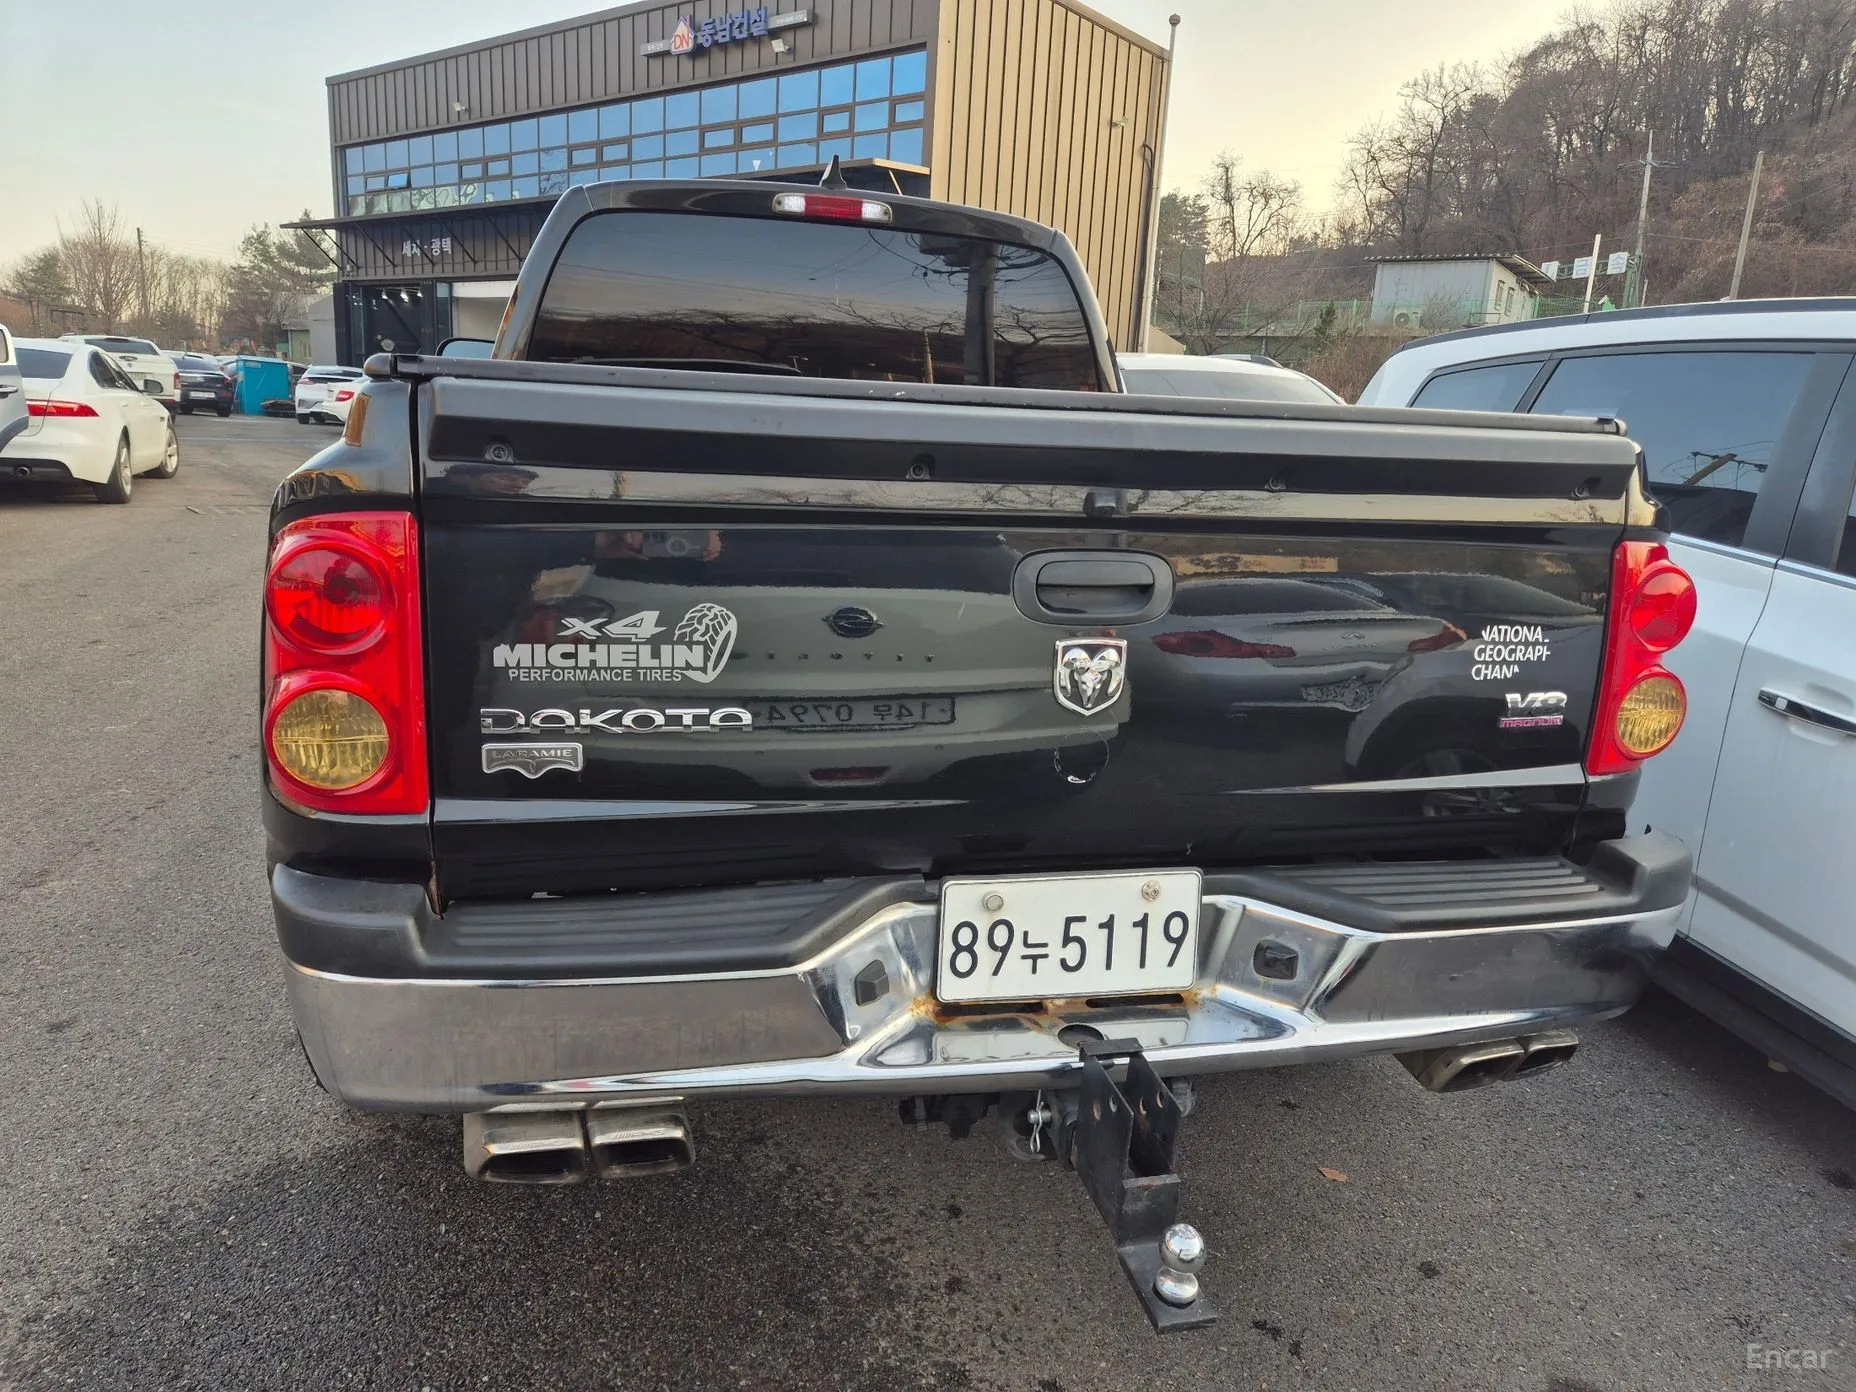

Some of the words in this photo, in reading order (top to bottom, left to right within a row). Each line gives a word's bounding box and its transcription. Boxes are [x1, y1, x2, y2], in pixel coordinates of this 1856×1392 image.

[701, 6, 768, 48] 동남건설
[1481, 625, 1550, 643] NATIONA
[493, 643, 704, 667] MICHELIN
[508, 668, 632, 682] PERFORMANCE
[637, 668, 682, 682] TIRES
[1505, 691, 1568, 717] V8
[480, 707, 753, 734] DAKOTA
[491, 749, 573, 759] LARAMIE
